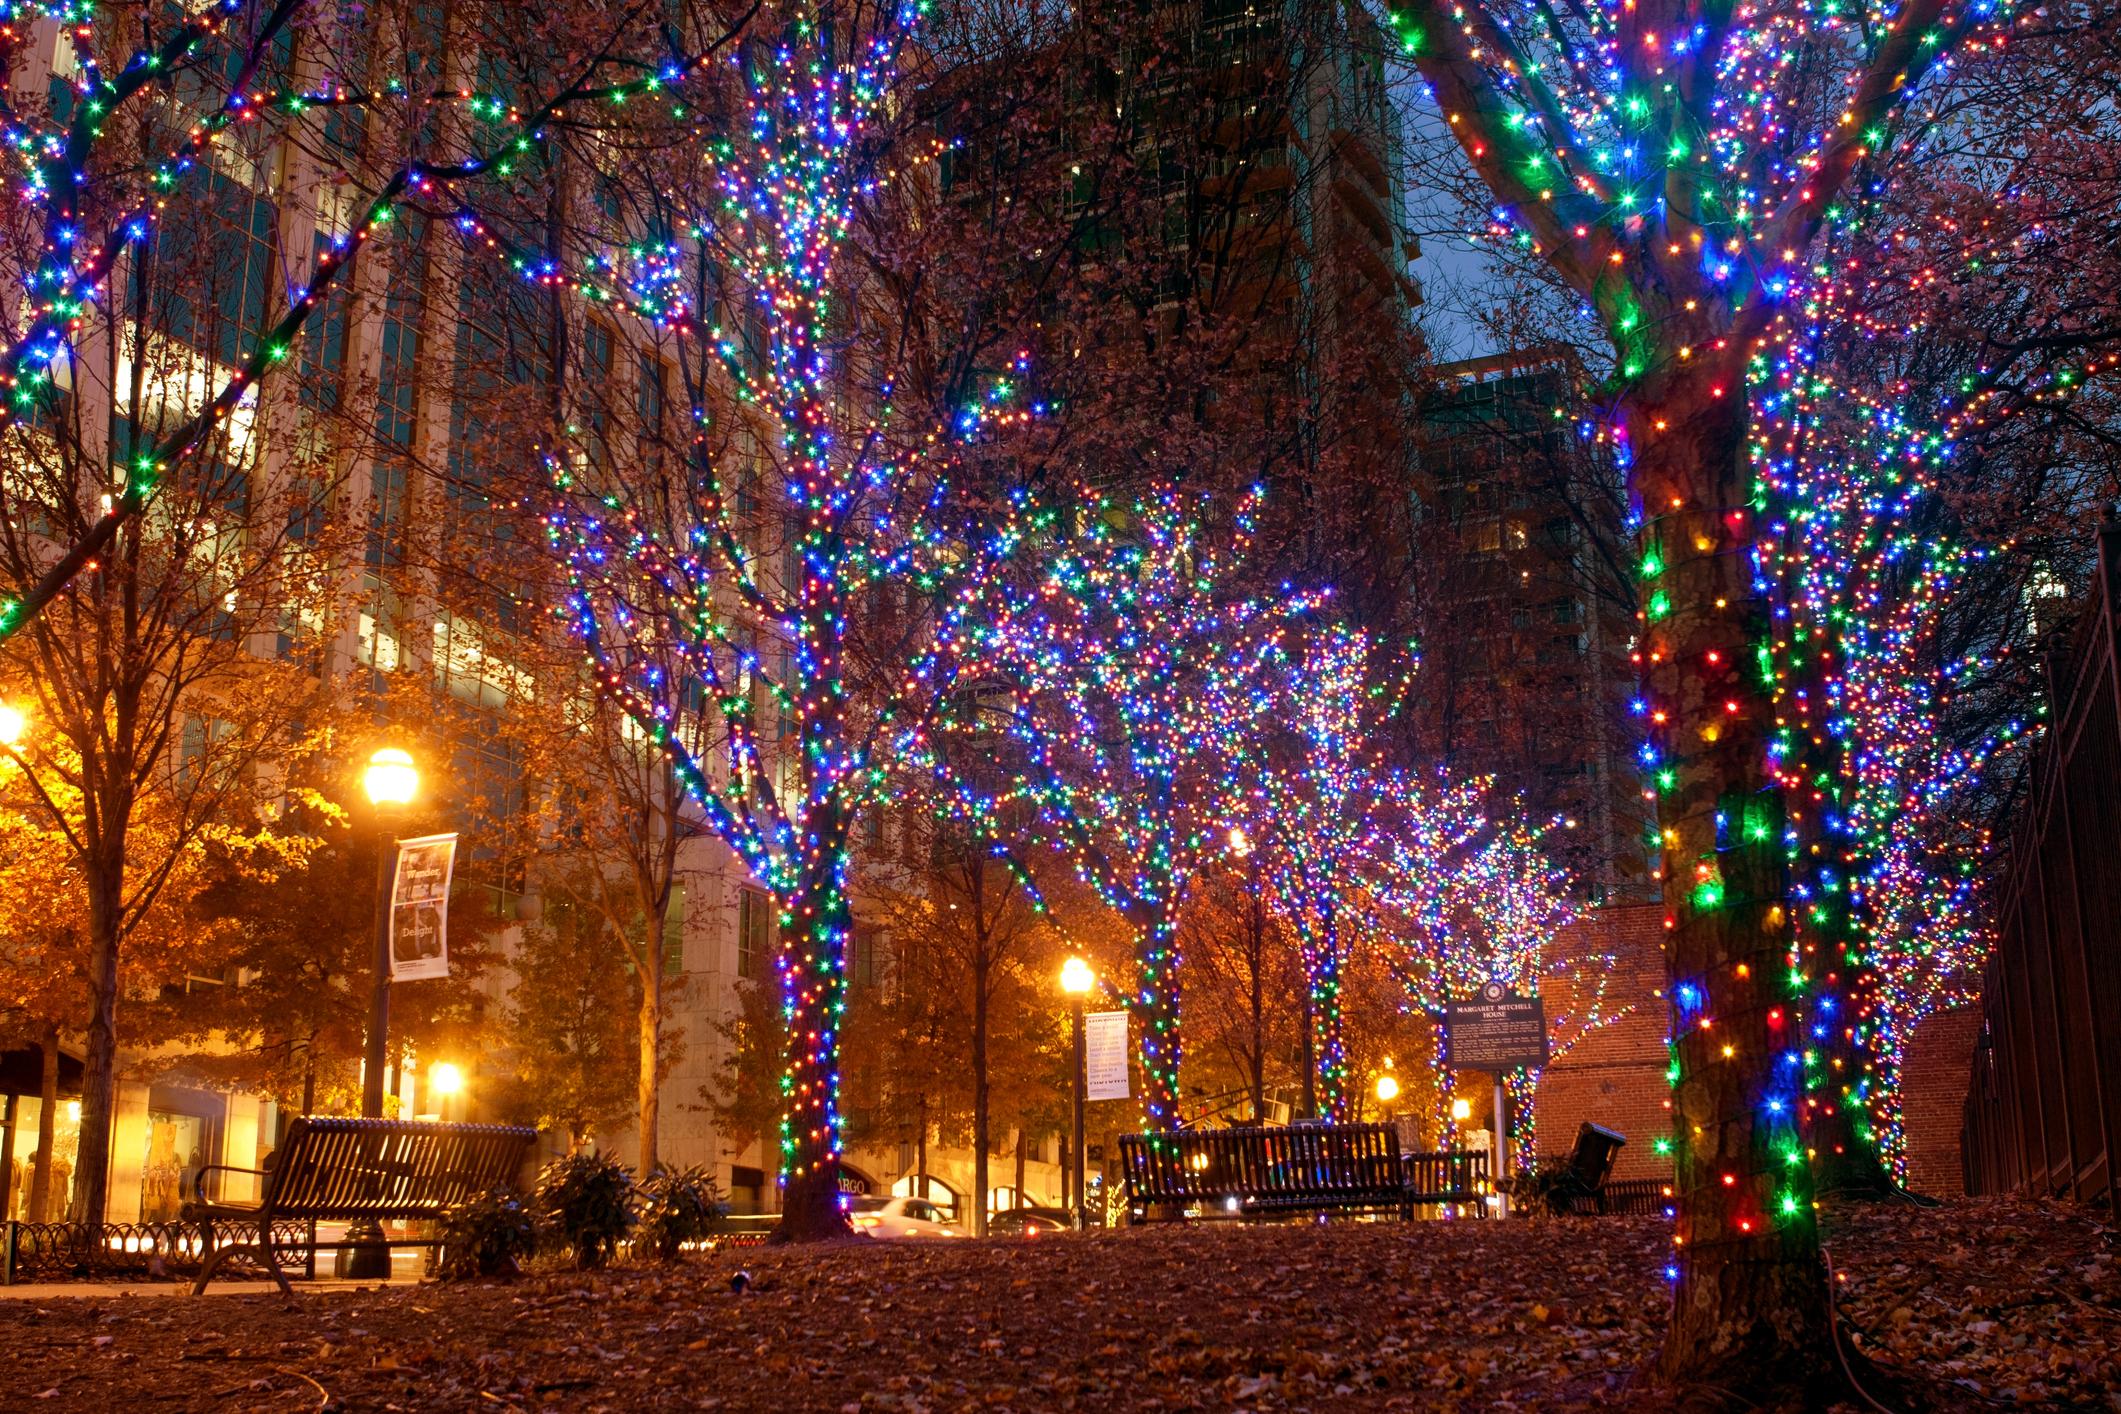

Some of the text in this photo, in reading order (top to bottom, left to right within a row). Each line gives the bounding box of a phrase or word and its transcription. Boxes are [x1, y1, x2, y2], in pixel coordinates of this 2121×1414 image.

[402, 926, 433, 937] Delight
[1457, 1003, 1532, 1013] MARGARET MITCHELL
